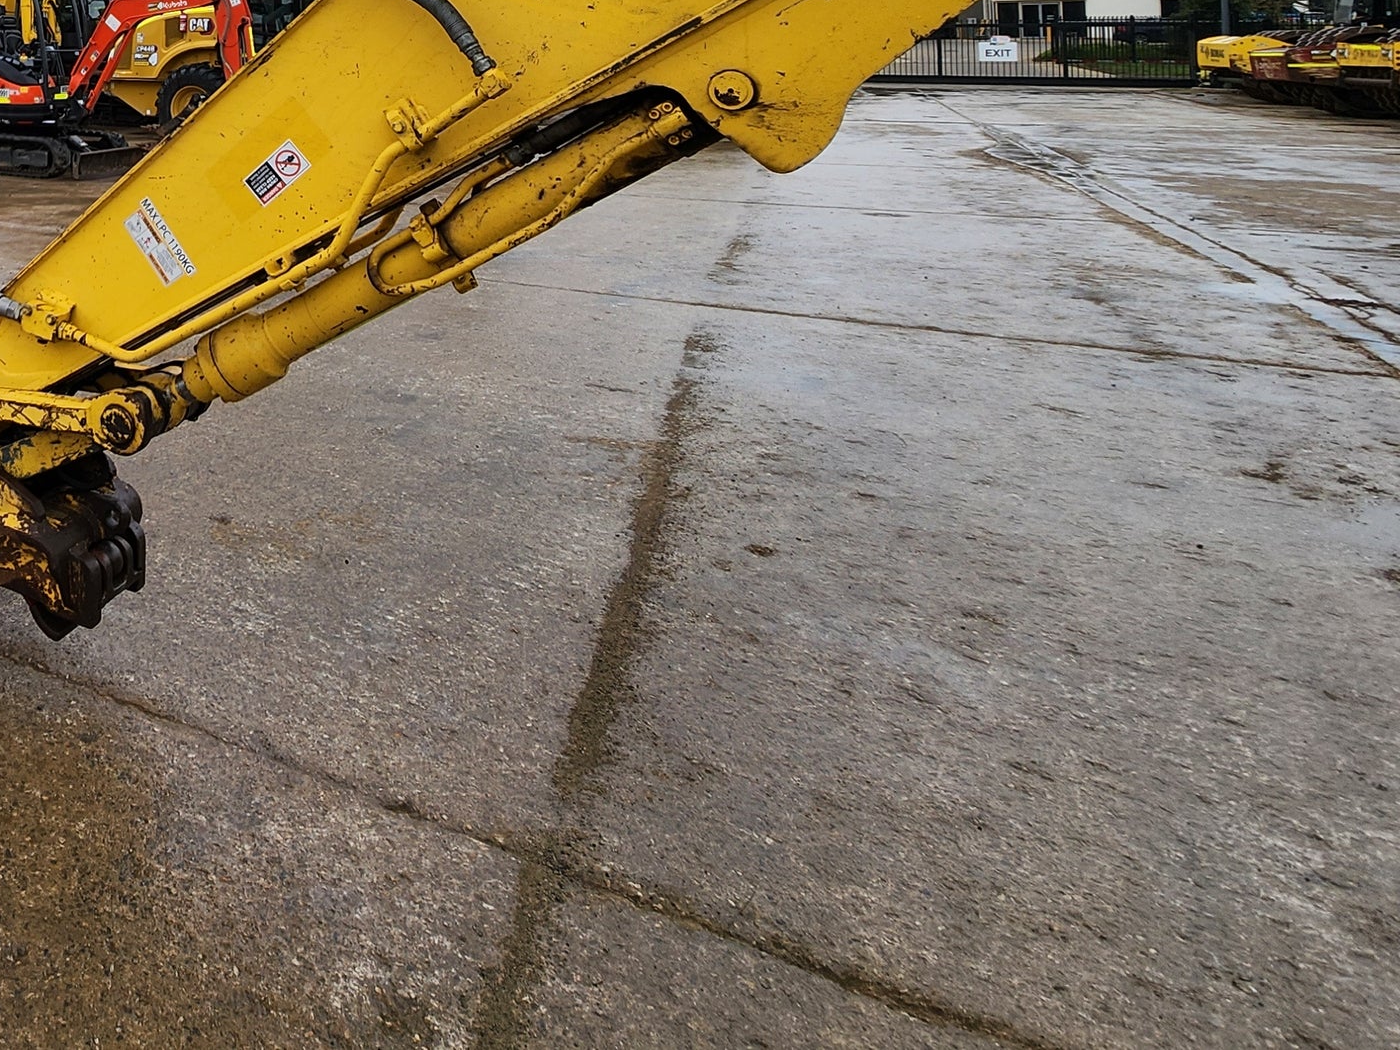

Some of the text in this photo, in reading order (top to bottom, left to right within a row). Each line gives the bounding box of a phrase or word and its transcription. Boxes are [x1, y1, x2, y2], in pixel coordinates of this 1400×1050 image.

[162, 0, 188, 10] Kubota
[189, 18, 210, 33] CAT
[985, 49, 1011, 57] EXIT
[141, 199, 158, 221] MAX
[155, 220, 171, 240] LPC
[167, 238, 194, 275] 1190KG
